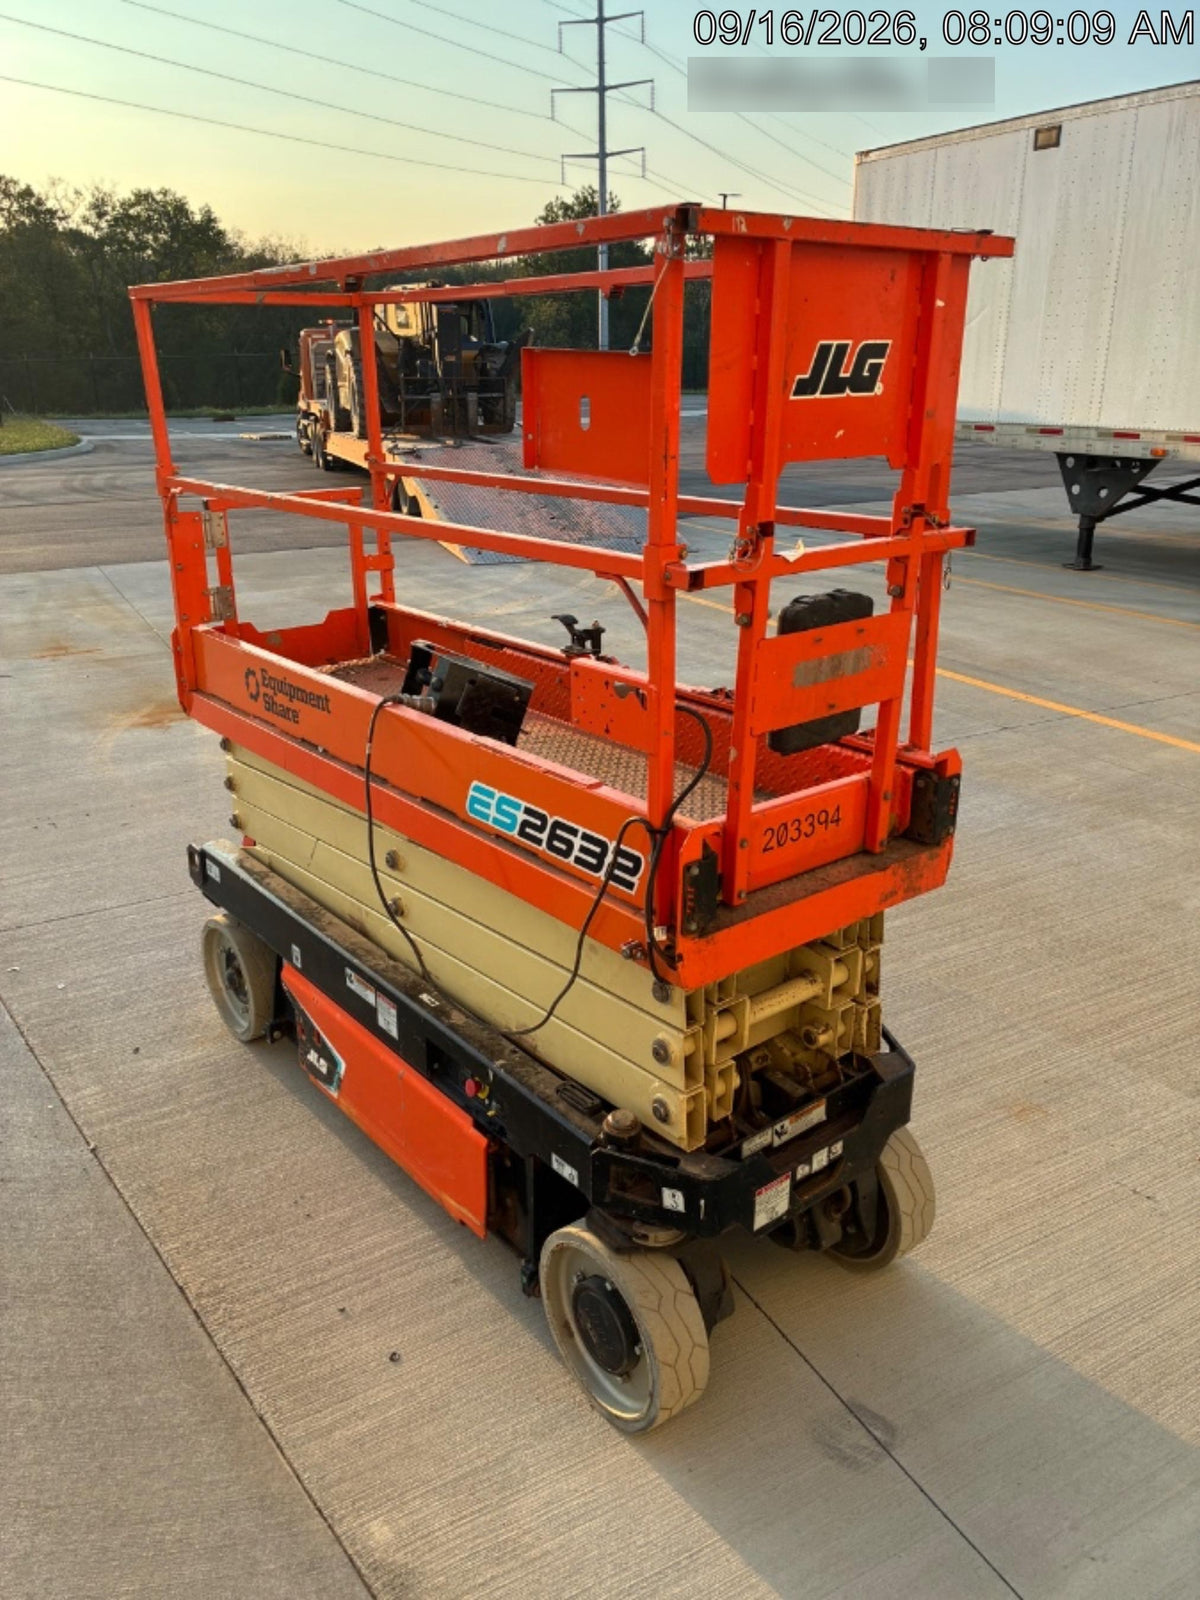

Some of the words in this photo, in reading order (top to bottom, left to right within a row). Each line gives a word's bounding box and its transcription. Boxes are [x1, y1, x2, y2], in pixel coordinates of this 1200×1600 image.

[790, 339, 892, 399] JLG
[260, 668, 331, 714] Equipment
[262, 693, 300, 724] Share
[466, 780, 645, 895] ES2632
[762, 804, 842, 852] 203394
